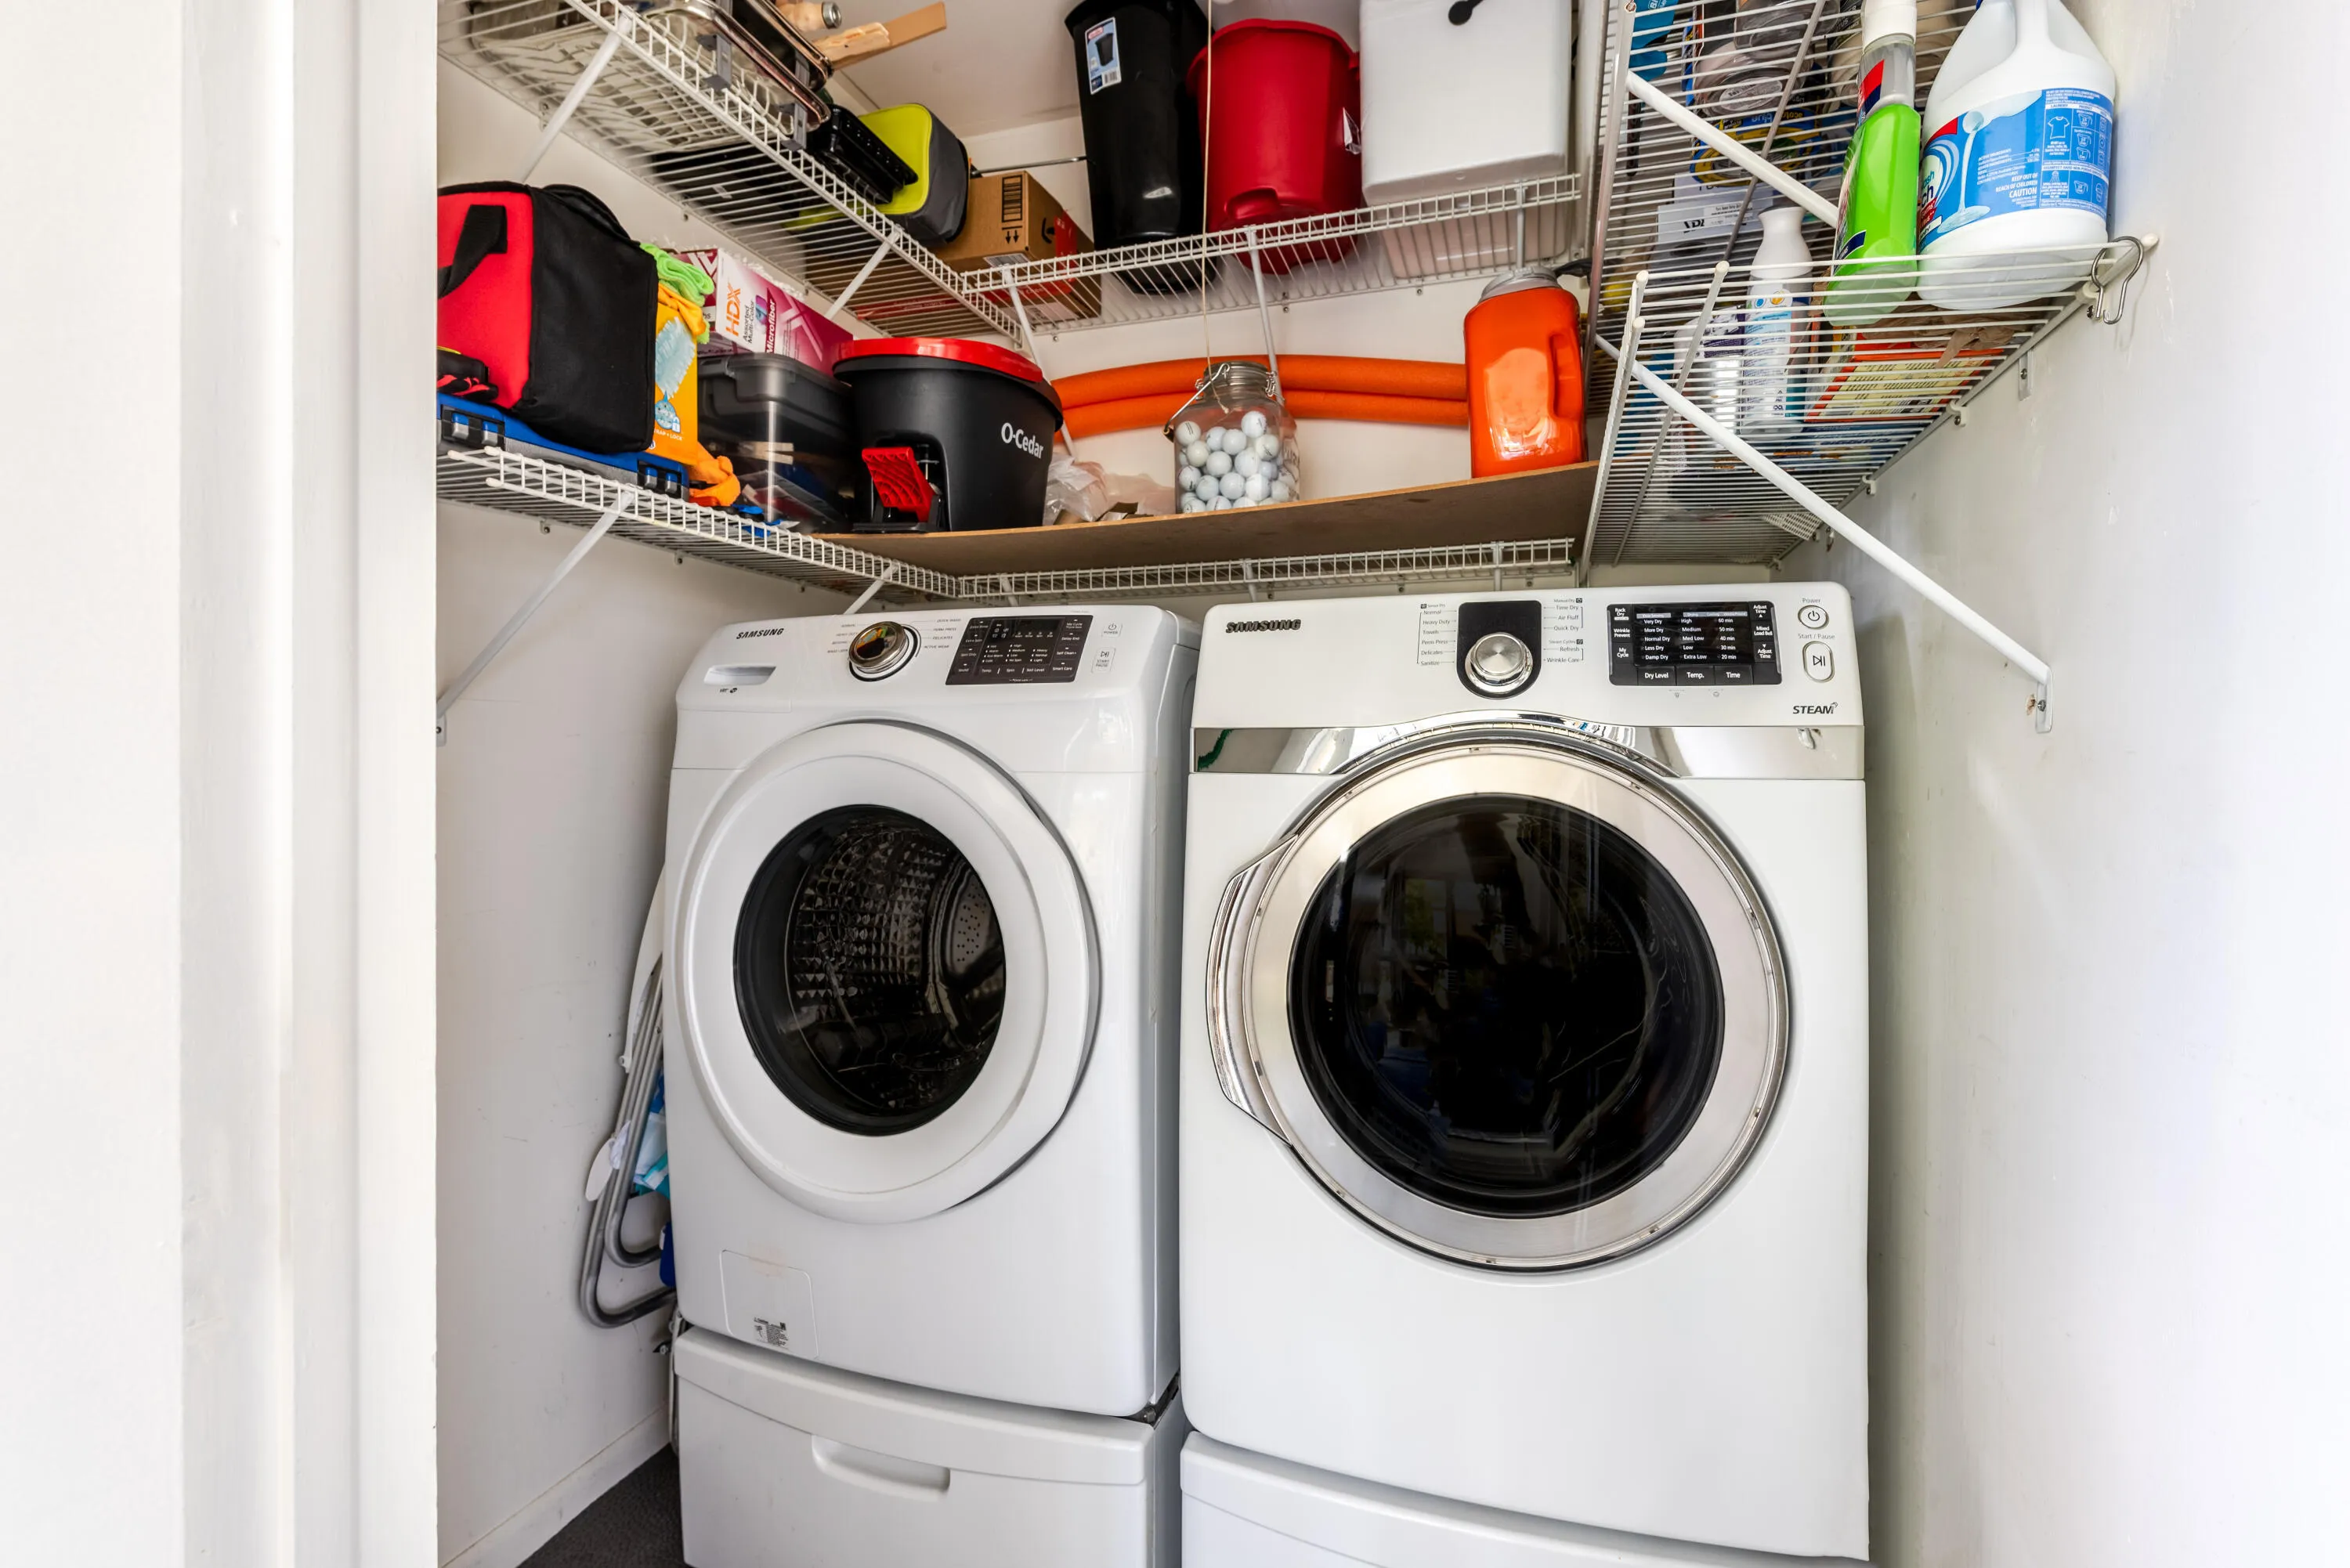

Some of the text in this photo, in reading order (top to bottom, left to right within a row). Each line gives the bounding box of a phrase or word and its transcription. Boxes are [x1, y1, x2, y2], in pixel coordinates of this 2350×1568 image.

[2008, 187, 2037, 198] CAUTION
[725, 282, 742, 337] HDX
[765, 299, 776, 353] Microfiber
[1001, 422, 1044, 459] O-Cedar
[1226, 619, 1302, 633] SAMSUNG
[736, 627, 784, 640] SAMSUNG
[1792, 705, 1834, 714] STEAM
